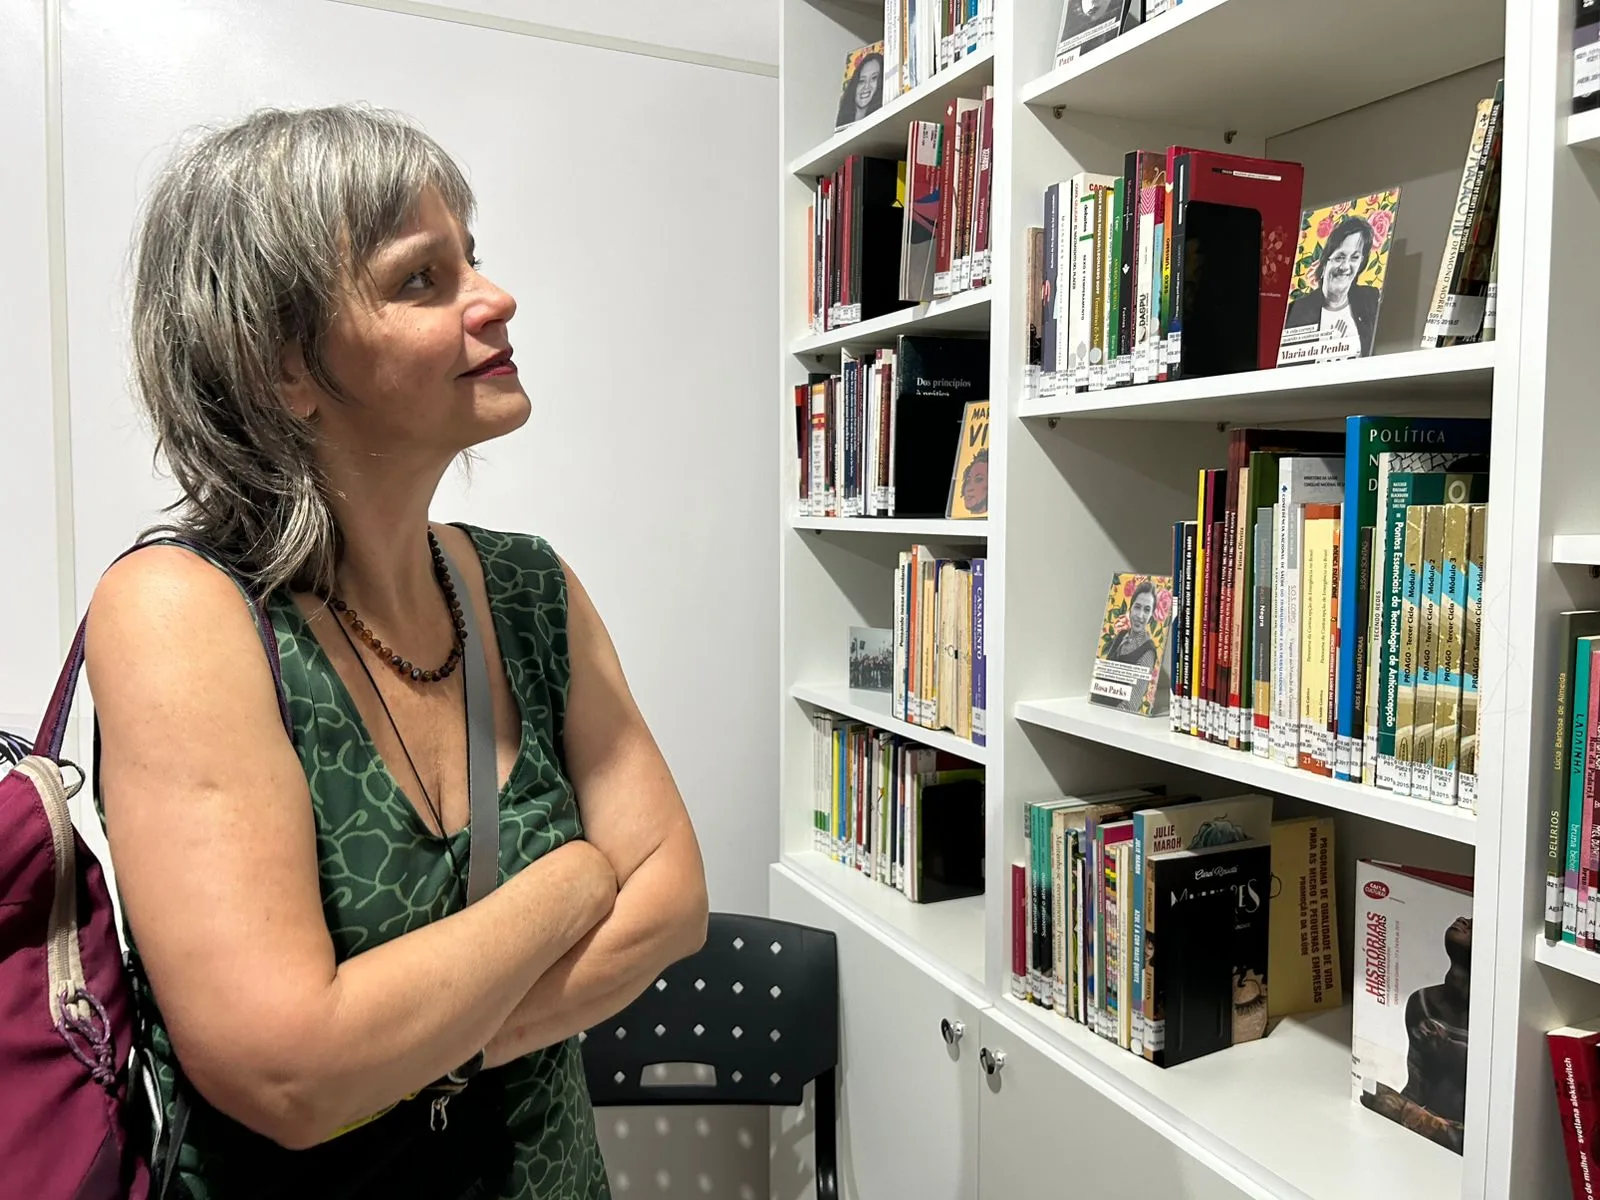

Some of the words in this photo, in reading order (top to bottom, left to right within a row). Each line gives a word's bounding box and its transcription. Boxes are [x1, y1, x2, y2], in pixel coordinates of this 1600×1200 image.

[1457, 156, 1480, 216] MACACO
[1443, 240, 1460, 282] DESMOND
[1139, 293, 1147, 327] DASPU
[1436, 284, 1449, 314] MORRI
[1282, 348, 1306, 360] Maria
[1307, 346, 1319, 357] da
[1320, 342, 1350, 355] Penha
[916, 377, 931, 387] Dos
[1369, 426, 1447, 443] POLÍTICA
[1280, 493, 1288, 532] CONFERÊNCIA
[1393, 521, 1404, 550] Pontos
[1360, 540, 1368, 567] SONTAG
[1359, 568, 1367, 591] SUSAN
[1391, 552, 1403, 594] Essenciais
[1408, 569, 1416, 598] Módulo
[1427, 565, 1436, 594] Módulo
[1448, 564, 1456, 594] Módulo
[1279, 588, 1284, 598] DO
[1391, 595, 1401, 607] da
[1258, 604, 1266, 627] Negra
[1426, 603, 1434, 621] Ciclo
[1447, 603, 1455, 620] Ciclo
[1471, 657, 1479, 689] PROAGO
[1476, 561, 1484, 591] Módulo
[1373, 612, 1381, 641] TECENDO
[1387, 609, 1400, 653] Tecnologia
[1406, 625, 1414, 646] Tercer
[1446, 622, 1454, 643] Tercer
[1355, 635, 1363, 673] METÁFORAS
[1389, 654, 1399, 666] de
[1403, 652, 1412, 683] PROAGO
[1423, 649, 1431, 681] PROAGO
[1444, 650, 1452, 682] PROAGO
[1093, 682, 1109, 694] Rosa
[1108, 685, 1128, 698] Parks
[1385, 667, 1398, 728] Anticoncepção
[1557, 672, 1567, 703] Almeida
[1556, 705, 1565, 715] de
[1555, 718, 1564, 748] Barbosa
[1573, 713, 1585, 775] LADAINHA
[1589, 736, 1597, 752] Rua
[1554, 751, 1562, 770] Lúcia
[1588, 754, 1596, 765] da
[1153, 825, 1175, 839] JULIE
[1153, 837, 1182, 853] MAROH
[1309, 827, 1318, 850] PARA
[1570, 824, 1579, 848] bruna
[1055, 834, 1063, 881] Mantenha-se
[1309, 852, 1317, 865] AS
[1319, 836, 1328, 885] PROGRAMA
[1298, 876, 1309, 916] PROMOÇÃO
[1309, 867, 1318, 897] MICRO
[1320, 887, 1328, 899] DE
[1369, 882, 1386, 892] CAIXA
[1300, 920, 1308, 930] DA
[1309, 908, 1320, 953] PEQUENAS
[1321, 902, 1331, 951] QUALIDADE
[1056, 930, 1064, 963] Feminina
[1300, 932, 1309, 957] SAÚDE
[1361, 911, 1381, 997] HISTÓRIAS
[1323, 954, 1332, 965] DE
[1311, 956, 1323, 1004] EMPRESAS
[1324, 967, 1334, 990] VIDA
[1564, 1057, 1579, 1107] aleksiévitch
[1572, 1108, 1585, 1144] svetlana
[1579, 1150, 1590, 1182] mulher
[1585, 1183, 1592, 1194] de
